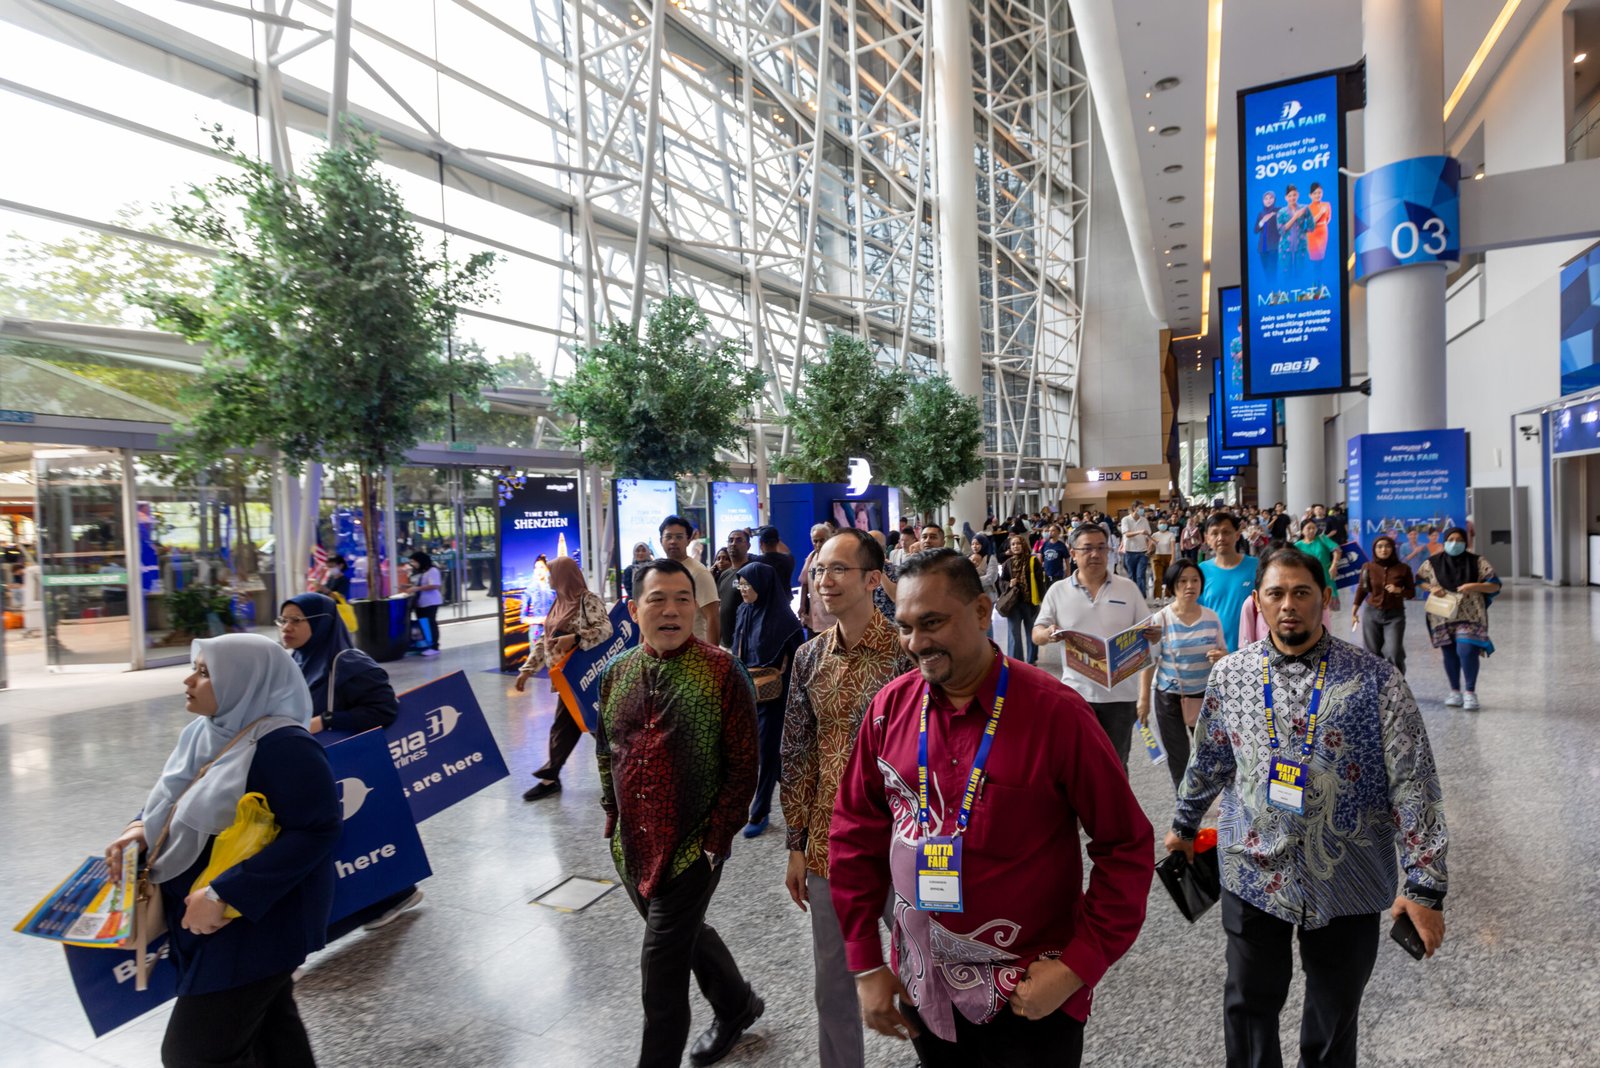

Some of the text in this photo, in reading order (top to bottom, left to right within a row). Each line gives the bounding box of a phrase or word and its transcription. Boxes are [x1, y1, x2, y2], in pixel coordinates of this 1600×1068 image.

[1255, 113, 1326, 136] MATTA FAIR
[1266, 137, 1316, 152] Discover the
[1256, 143, 1329, 162] best deals of up to
[1255, 151, 1330, 180] 30% off
[1391, 217, 1447, 260] 03
[1227, 305, 1241, 313] MAT
[1260, 308, 1331, 322] Join us for activities
[1275, 319, 1304, 329] exciting
[1304, 316, 1331, 325] reveals
[1263, 330, 1271, 338] at
[1272, 328, 1284, 337] the
[1285, 326, 1303, 335] MAG
[1283, 335, 1302, 344] Level
[1270, 361, 1303, 373] mag
[1383, 453, 1439, 463] MATTA FAIR
[514, 517, 568, 530] SHENZHEN
[985, 696, 1005, 736] MATTA FAIR
[387, 731, 427, 760] sia
[412, 772, 443, 793] are
[442, 752, 484, 777] here
[1276, 762, 1302, 777] MATTA
[1278, 771, 1297, 784] FAIR
[918, 766, 928, 809] MATTA FAIR
[962, 768, 982, 811] MATTA FAIR
[923, 843, 954, 857] MATTA
[334, 844, 397, 879] here
[927, 856, 949, 868] FAIR
